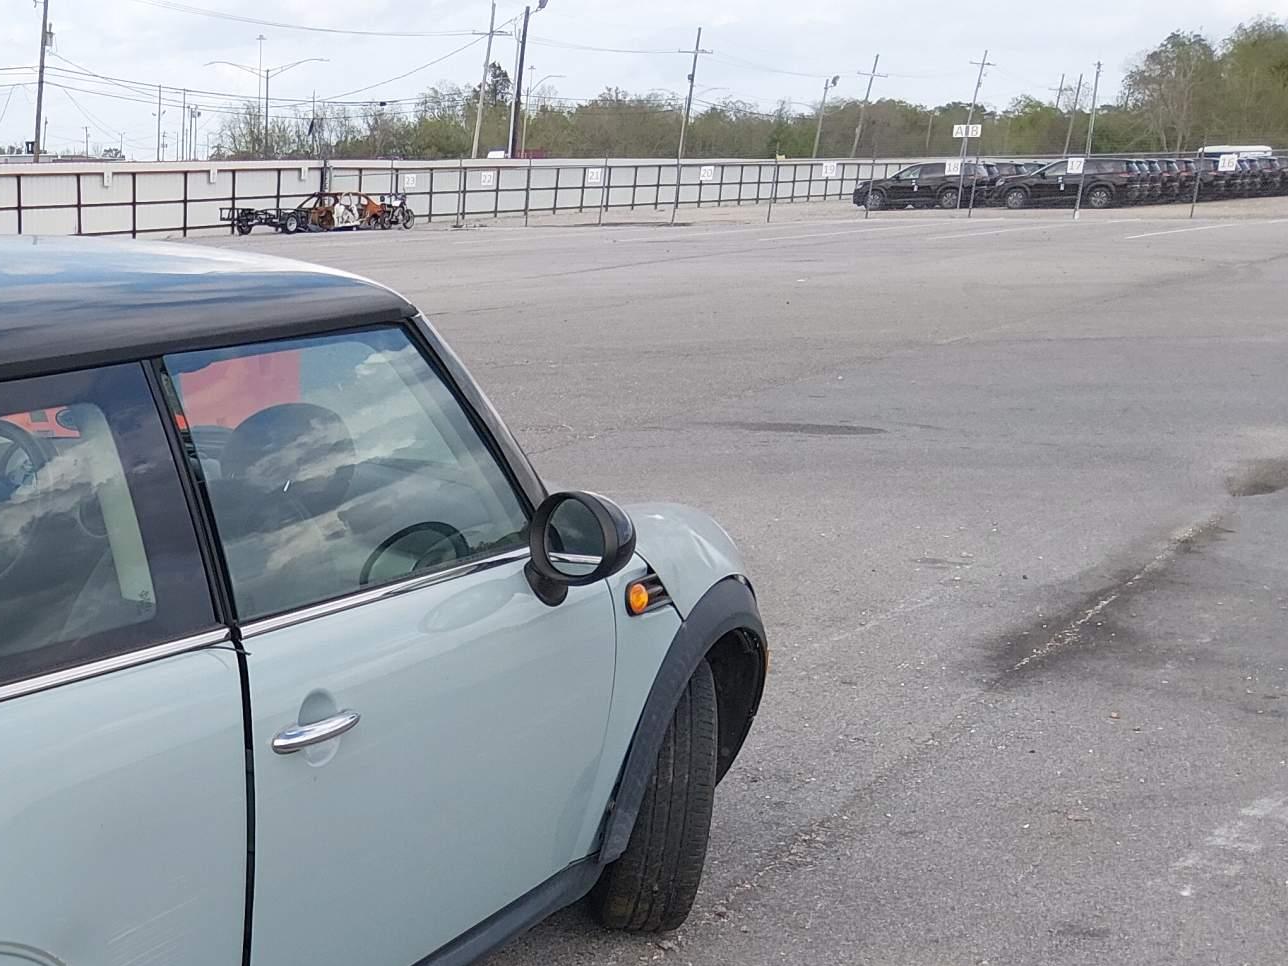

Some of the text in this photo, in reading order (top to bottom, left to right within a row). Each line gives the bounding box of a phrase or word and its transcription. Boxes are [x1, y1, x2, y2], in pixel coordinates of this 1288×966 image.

[955, 125, 979, 137] A B
[947, 161, 958, 172] 18
[1070, 160, 1081, 171] 17
[1221, 158, 1234, 168] 16
[589, 170, 600, 180] 21
[701, 168, 713, 178] 20
[824, 165, 835, 175] 19
[405, 175, 415, 185] 23
[482, 174, 492, 183] 22
